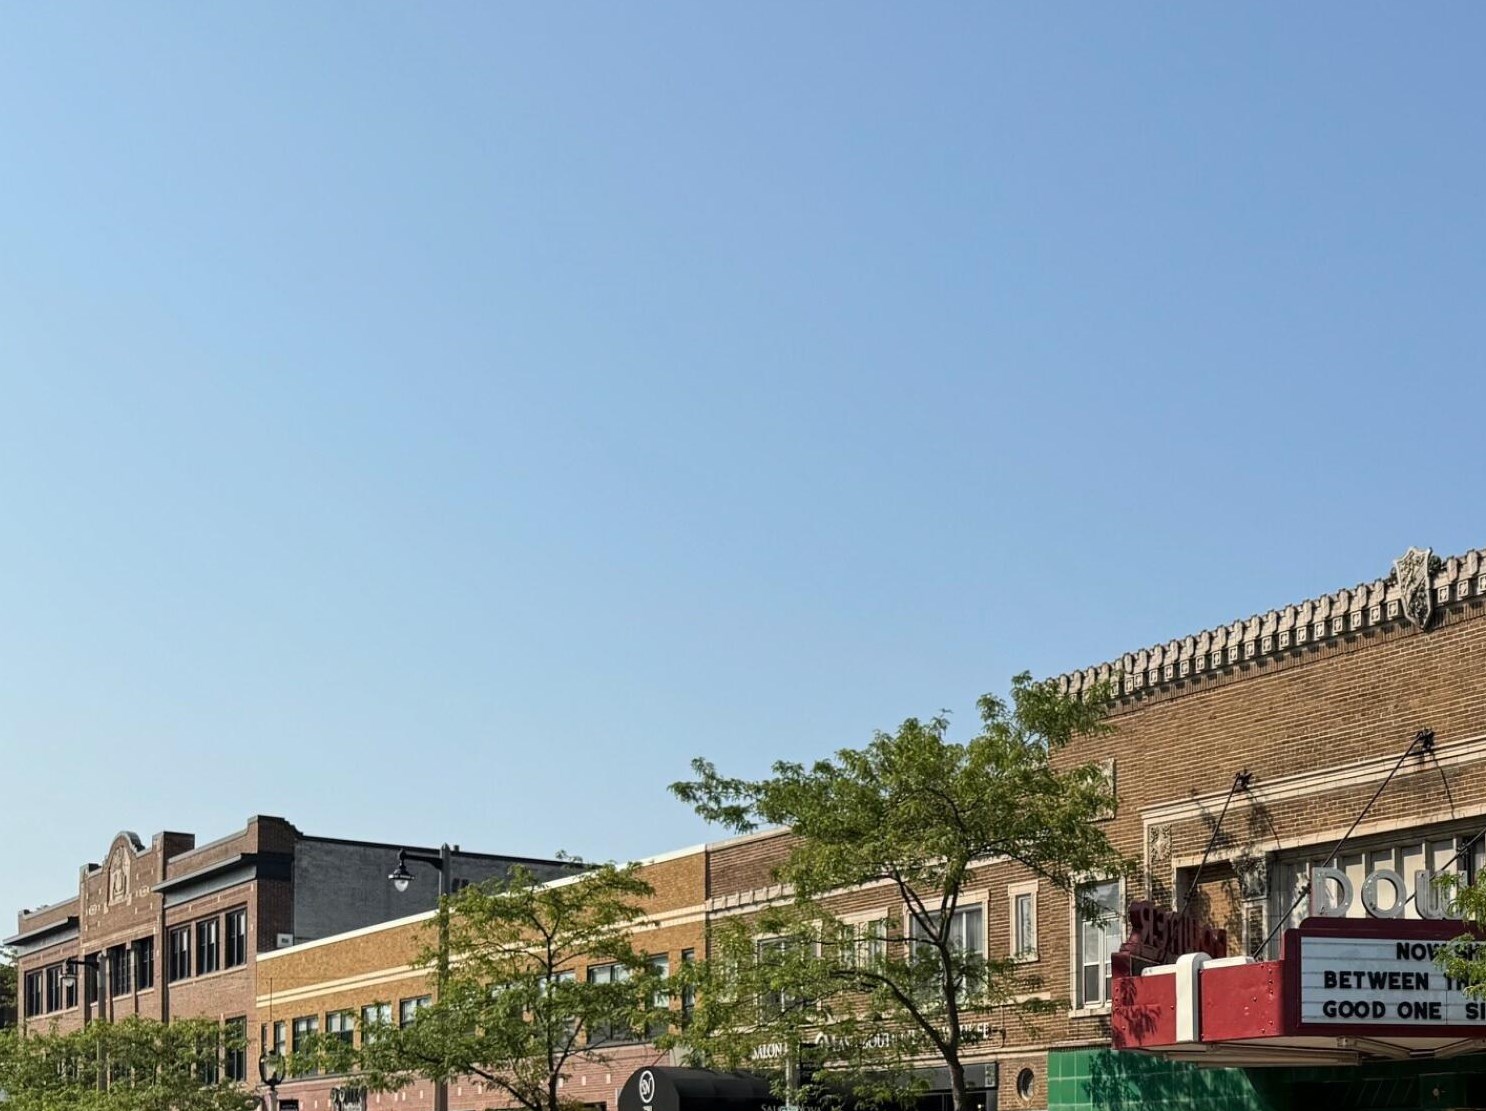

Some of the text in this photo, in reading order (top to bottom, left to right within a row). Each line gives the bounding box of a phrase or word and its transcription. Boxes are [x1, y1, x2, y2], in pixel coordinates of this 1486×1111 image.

[1324, 970, 1429, 990] BETWEEN
[1323, 1000, 1386, 1018] GOOD
[1397, 1001, 1442, 1019] ONE
